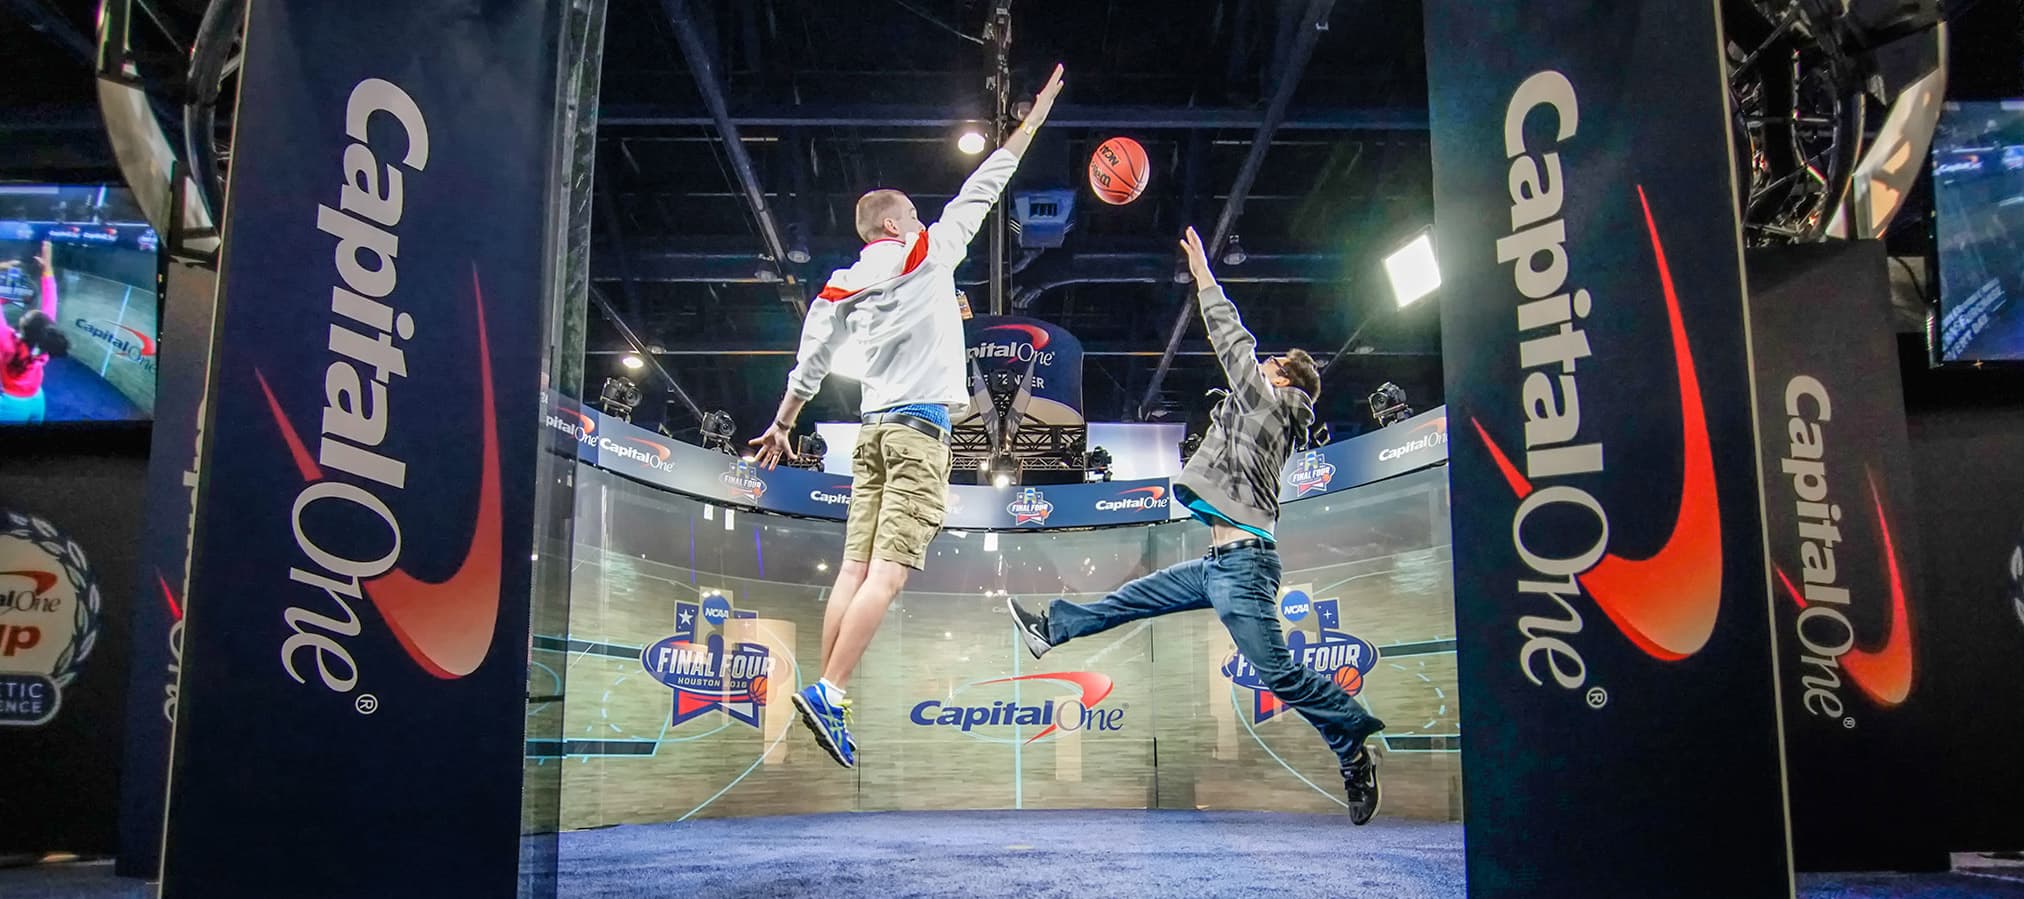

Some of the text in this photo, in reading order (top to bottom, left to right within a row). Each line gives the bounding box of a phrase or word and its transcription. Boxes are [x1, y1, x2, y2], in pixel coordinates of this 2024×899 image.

[966, 342, 1055, 366] pitalOne
[546, 415, 597, 447] pitalOne
[1379, 431, 1448, 462] CapitalOn
[705, 607, 729, 618] NCAA
[1284, 604, 1309, 615] NCAA
[657, 647, 777, 680] FINAL FOUR
[1303, 644, 1361, 672] FOUR
[678, 677, 720, 687] HOUSTON
